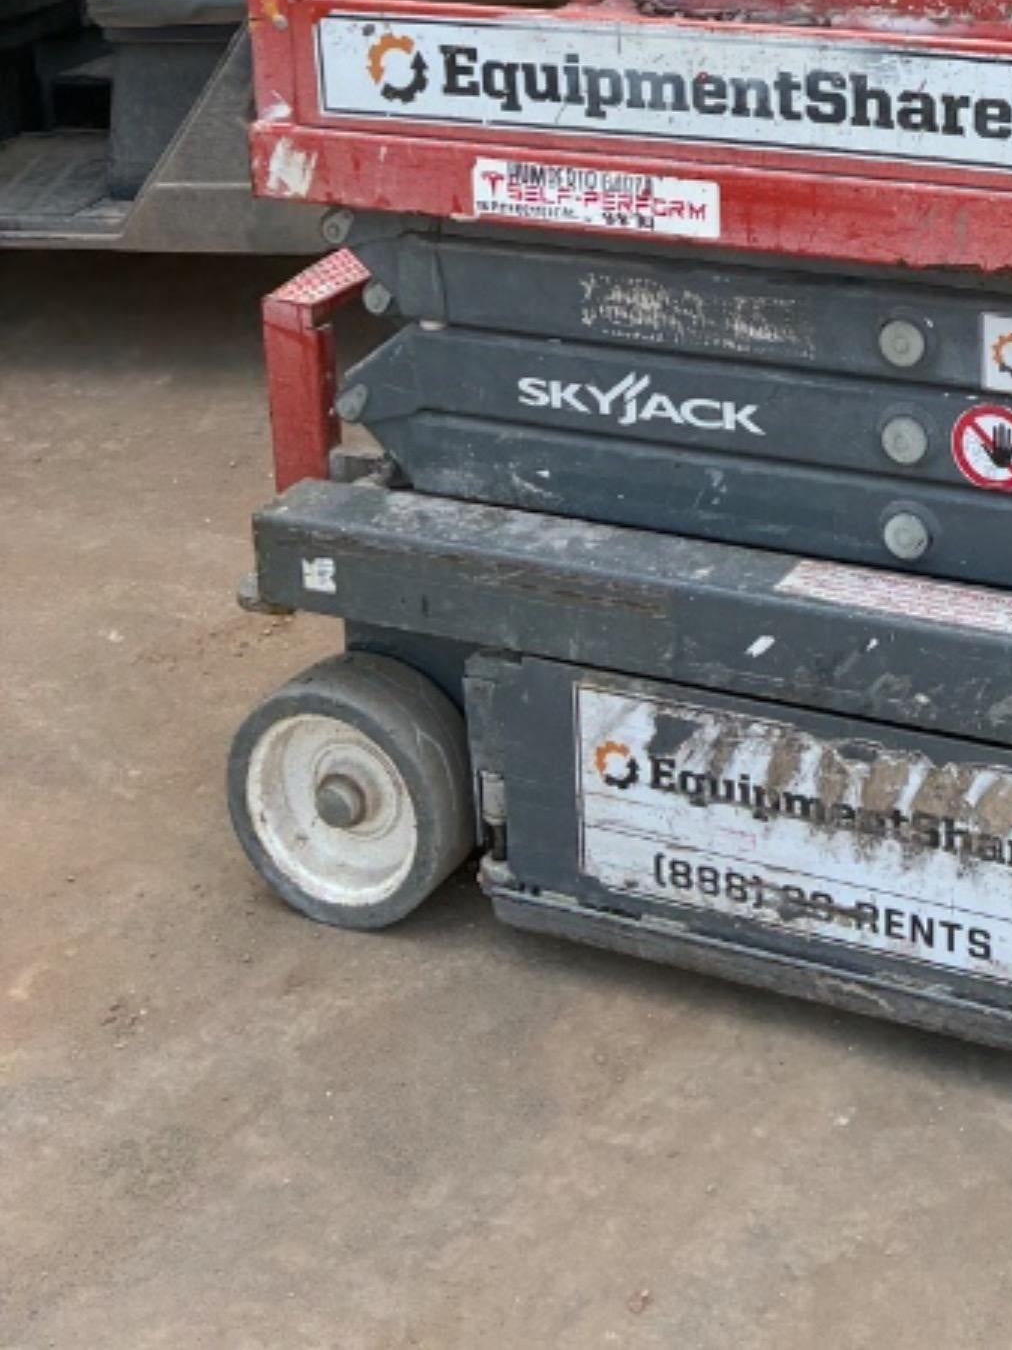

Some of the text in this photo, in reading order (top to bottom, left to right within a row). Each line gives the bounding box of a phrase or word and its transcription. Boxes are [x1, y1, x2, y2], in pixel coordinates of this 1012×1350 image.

[506, 184, 708, 222] SELF-PERFORM
[517, 371, 766, 436] SKYJACK
[653, 852, 764, 909] (888)
